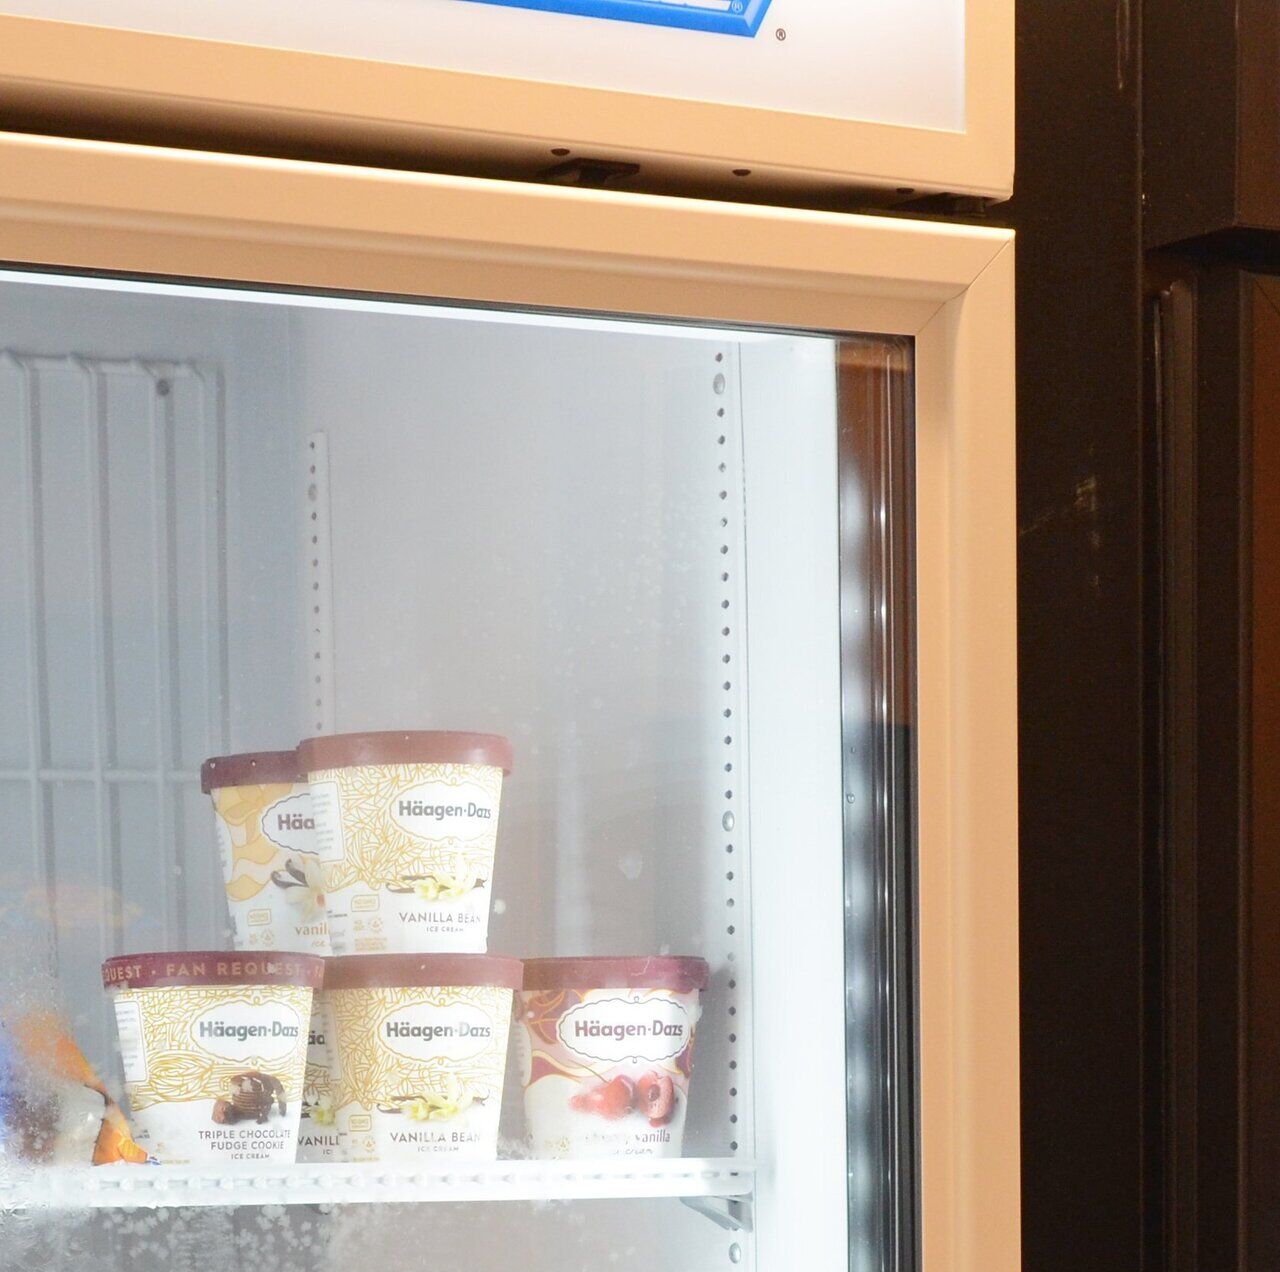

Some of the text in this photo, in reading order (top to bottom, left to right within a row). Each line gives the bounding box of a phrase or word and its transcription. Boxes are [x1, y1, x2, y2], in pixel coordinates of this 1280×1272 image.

[399, 912, 453, 923] VANILLA
[167, 961, 301, 976] FAN REQUEST
[198, 1129, 291, 1140] TRIPLE CHOCOLATE
[390, 1131, 447, 1143] VANILLA
[211, 1140, 284, 1151] FUDGE COOKIE
